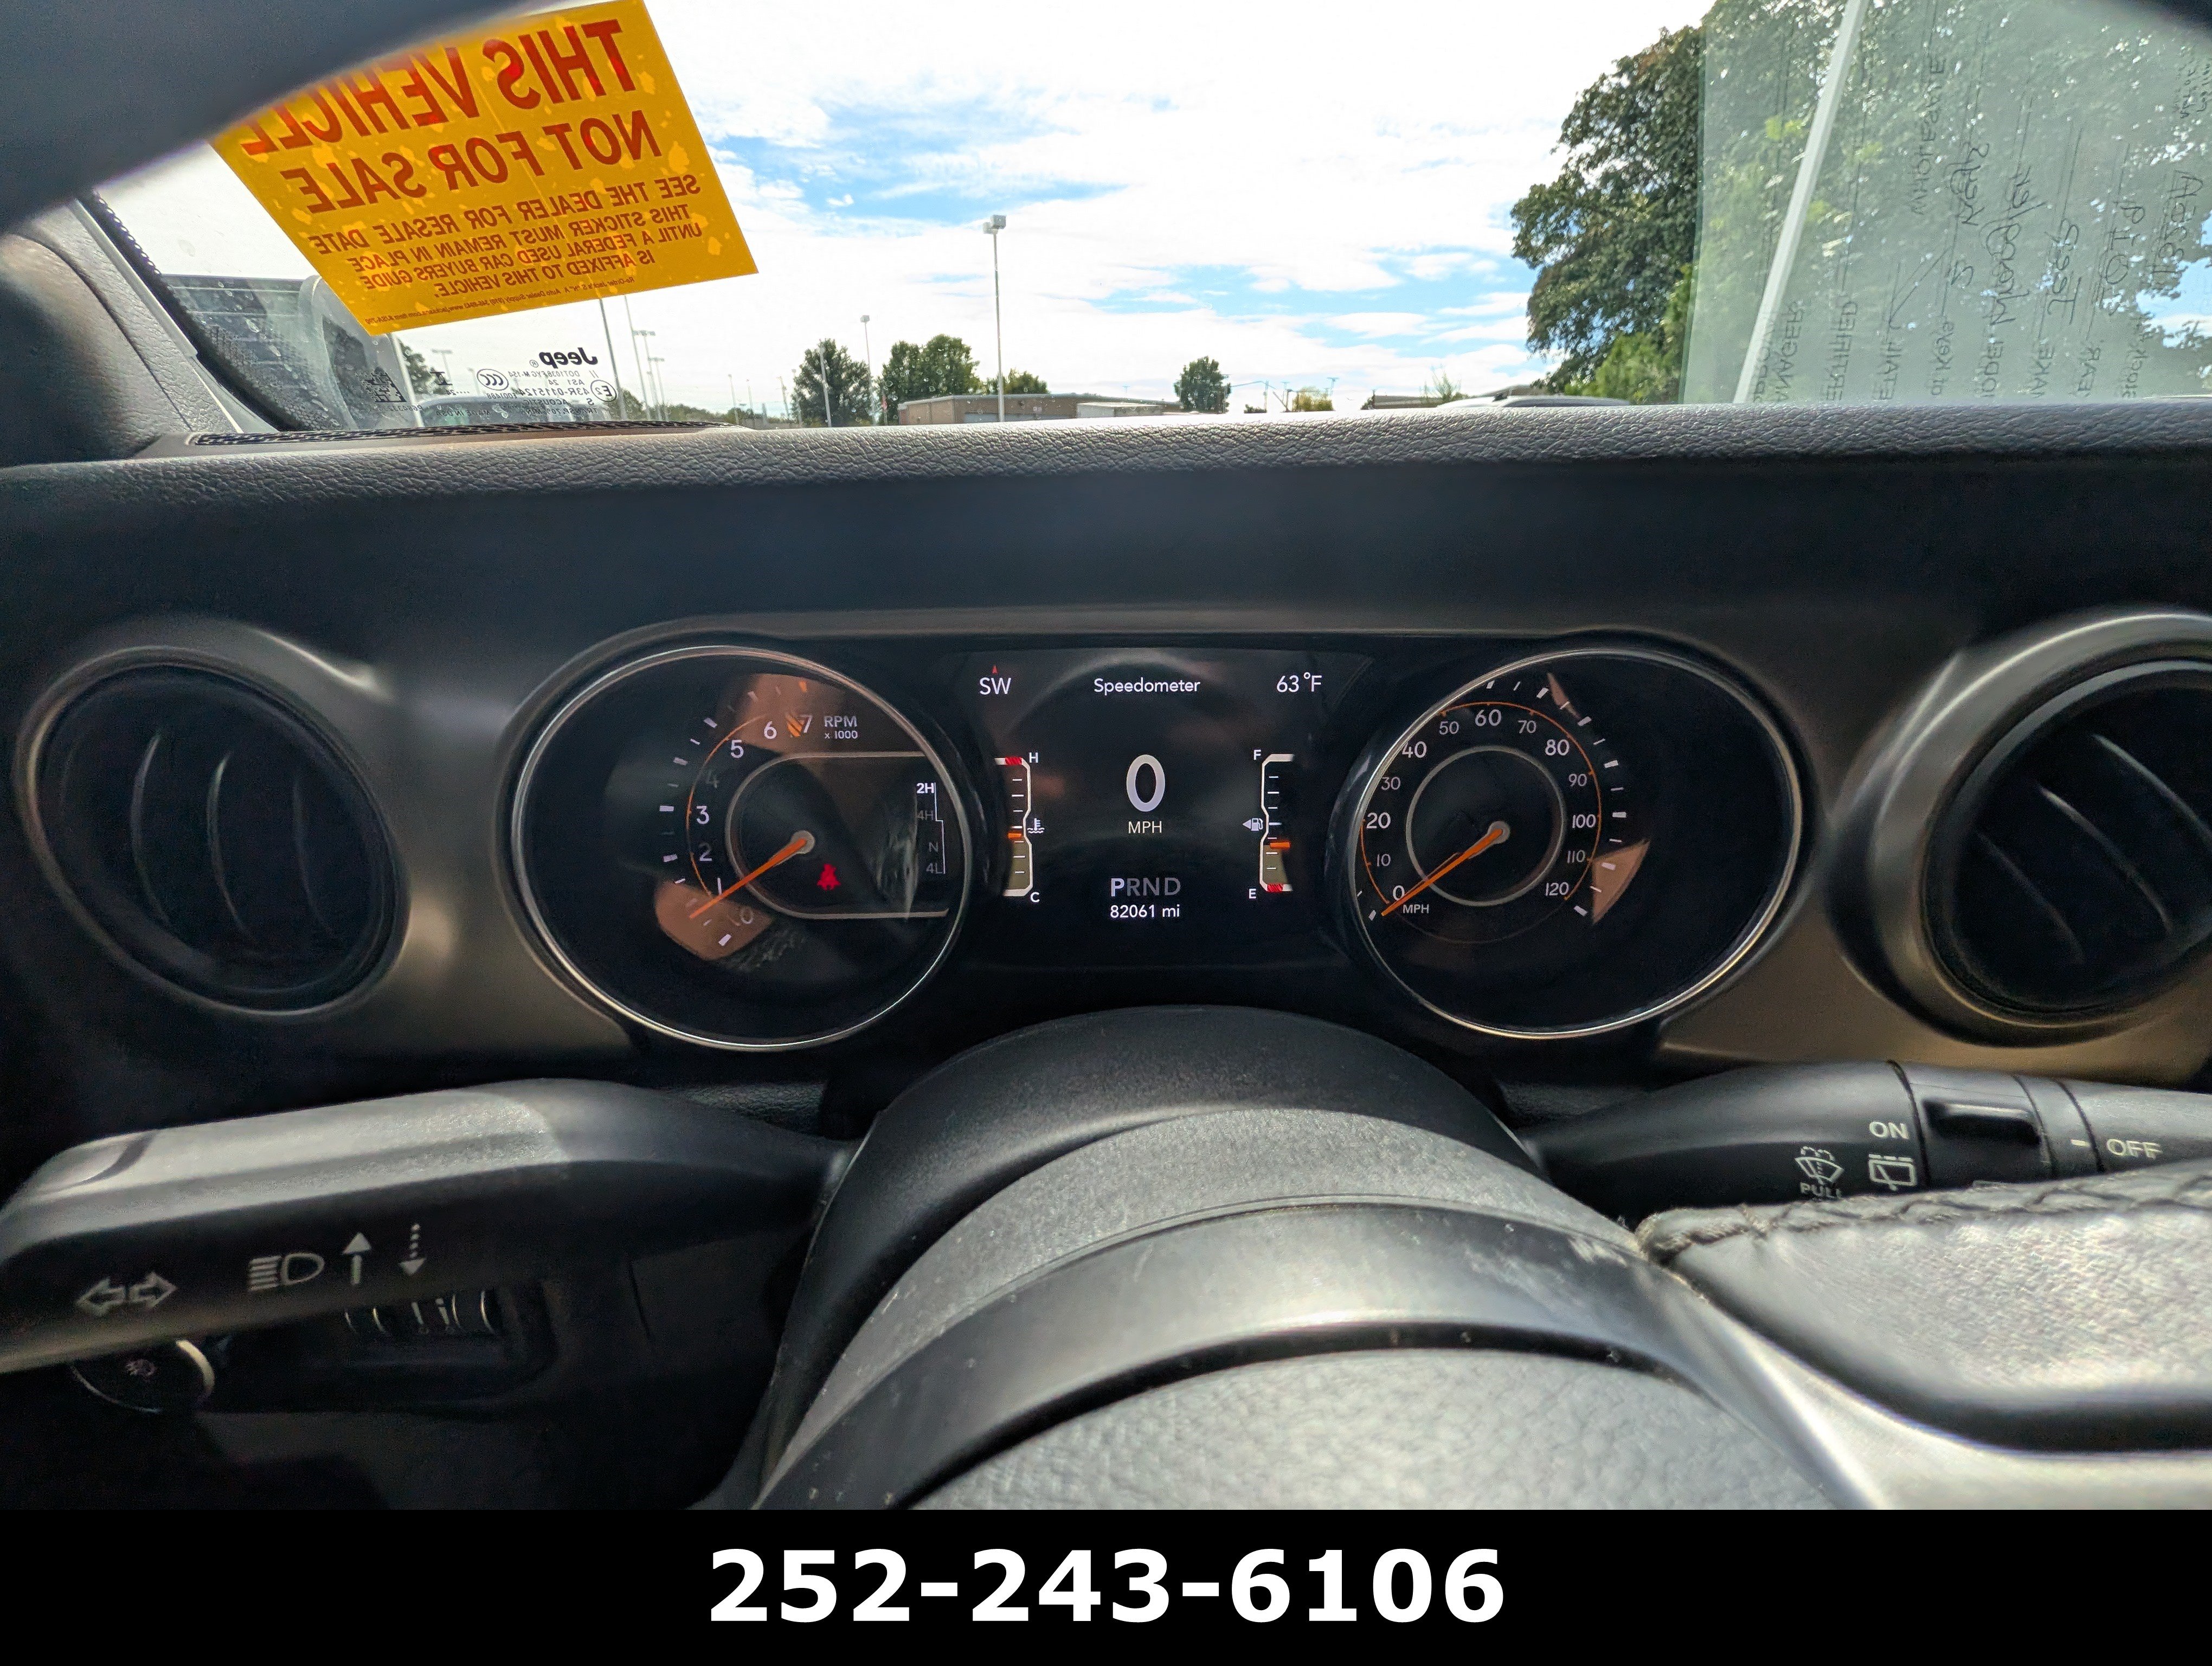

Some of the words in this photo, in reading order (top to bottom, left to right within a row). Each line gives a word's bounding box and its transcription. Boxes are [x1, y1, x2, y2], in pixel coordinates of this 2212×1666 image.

[979, 677, 1011, 695] SW
[1094, 678, 1200, 696] Speedometer
[824, 715, 858, 727] RPM
[1475, 709, 1502, 727] 60
[764, 721, 776, 740] 6
[1439, 721, 1459, 735] 50
[1518, 720, 1536, 734] 70
[833, 730, 858, 739] 1000
[730, 740, 744, 759] 5
[1401, 741, 1427, 758] 40
[1545, 739, 1570, 756] 80
[1030, 752, 1039, 763] H
[1253, 750, 1261, 760] F
[1126, 754, 1166, 812] 0
[1381, 777, 1401, 790] 30
[1568, 773, 1587, 787] 90
[916, 782, 934, 794] 2H
[696, 805, 710, 824] 3
[916, 810, 934, 821] 4H
[1367, 813, 1391, 829] 20
[1572, 814, 1596, 829] 100
[1128, 821, 1162, 834] MPH
[698, 842, 712, 862] 2
[929, 842, 938, 853] N
[1377, 854, 1391, 867] 10
[1567, 850, 1585, 863] 110
[926, 862, 943, 874] 4L
[1249, 889, 1257, 899] E
[1393, 886, 1405, 901] 0
[1545, 882, 1569, 896] 120
[1031, 892, 1040, 904] C
[740, 907, 754, 924] 0
[1110, 905, 1155, 918] 82061
[1162, 905, 1180, 918] mi
[1403, 904, 1430, 914] MPH
[1869, 1120, 1908, 1139] ON
[2106, 1138, 2163, 1159] OFF
